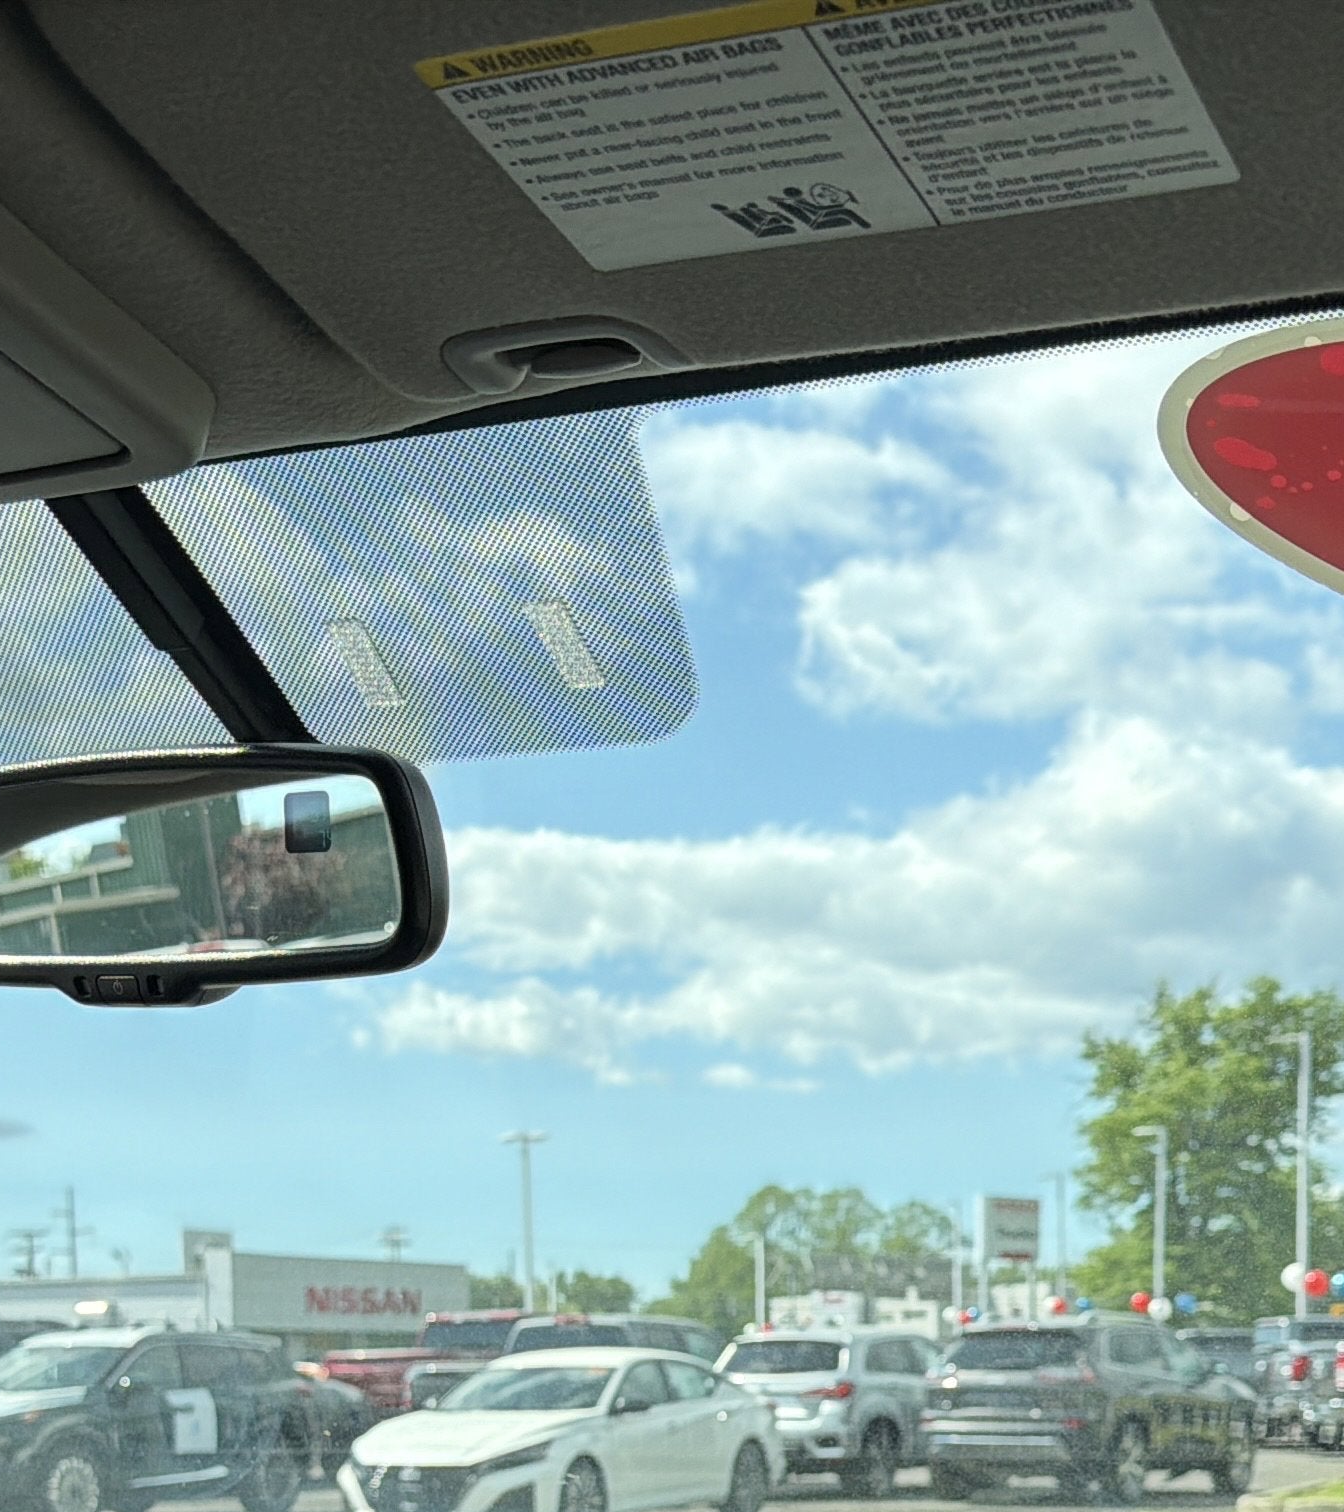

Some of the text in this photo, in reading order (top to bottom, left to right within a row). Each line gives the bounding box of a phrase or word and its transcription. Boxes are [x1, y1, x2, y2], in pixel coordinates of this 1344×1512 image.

[452, 37, 782, 104] EVEN WITH ADVANCED AIR BAGS
[470, 39, 594, 73] WARNING
[477, 103, 538, 119] Children
[540, 98, 567, 108] can
[568, 94, 589, 104] be
[589, 87, 632, 99] killed
[654, 74, 721, 89] seriously
[723, 62, 779, 79] injured
[486, 107, 586, 132] by the air bag
[503, 90, 828, 148] The back seat is the safest place for children
[519, 108, 843, 166] Never put a rear-facing child seat in the front
[536, 133, 832, 185] Always use seat belts and child restraints
[305, 1286, 422, 1315] NISSAN
